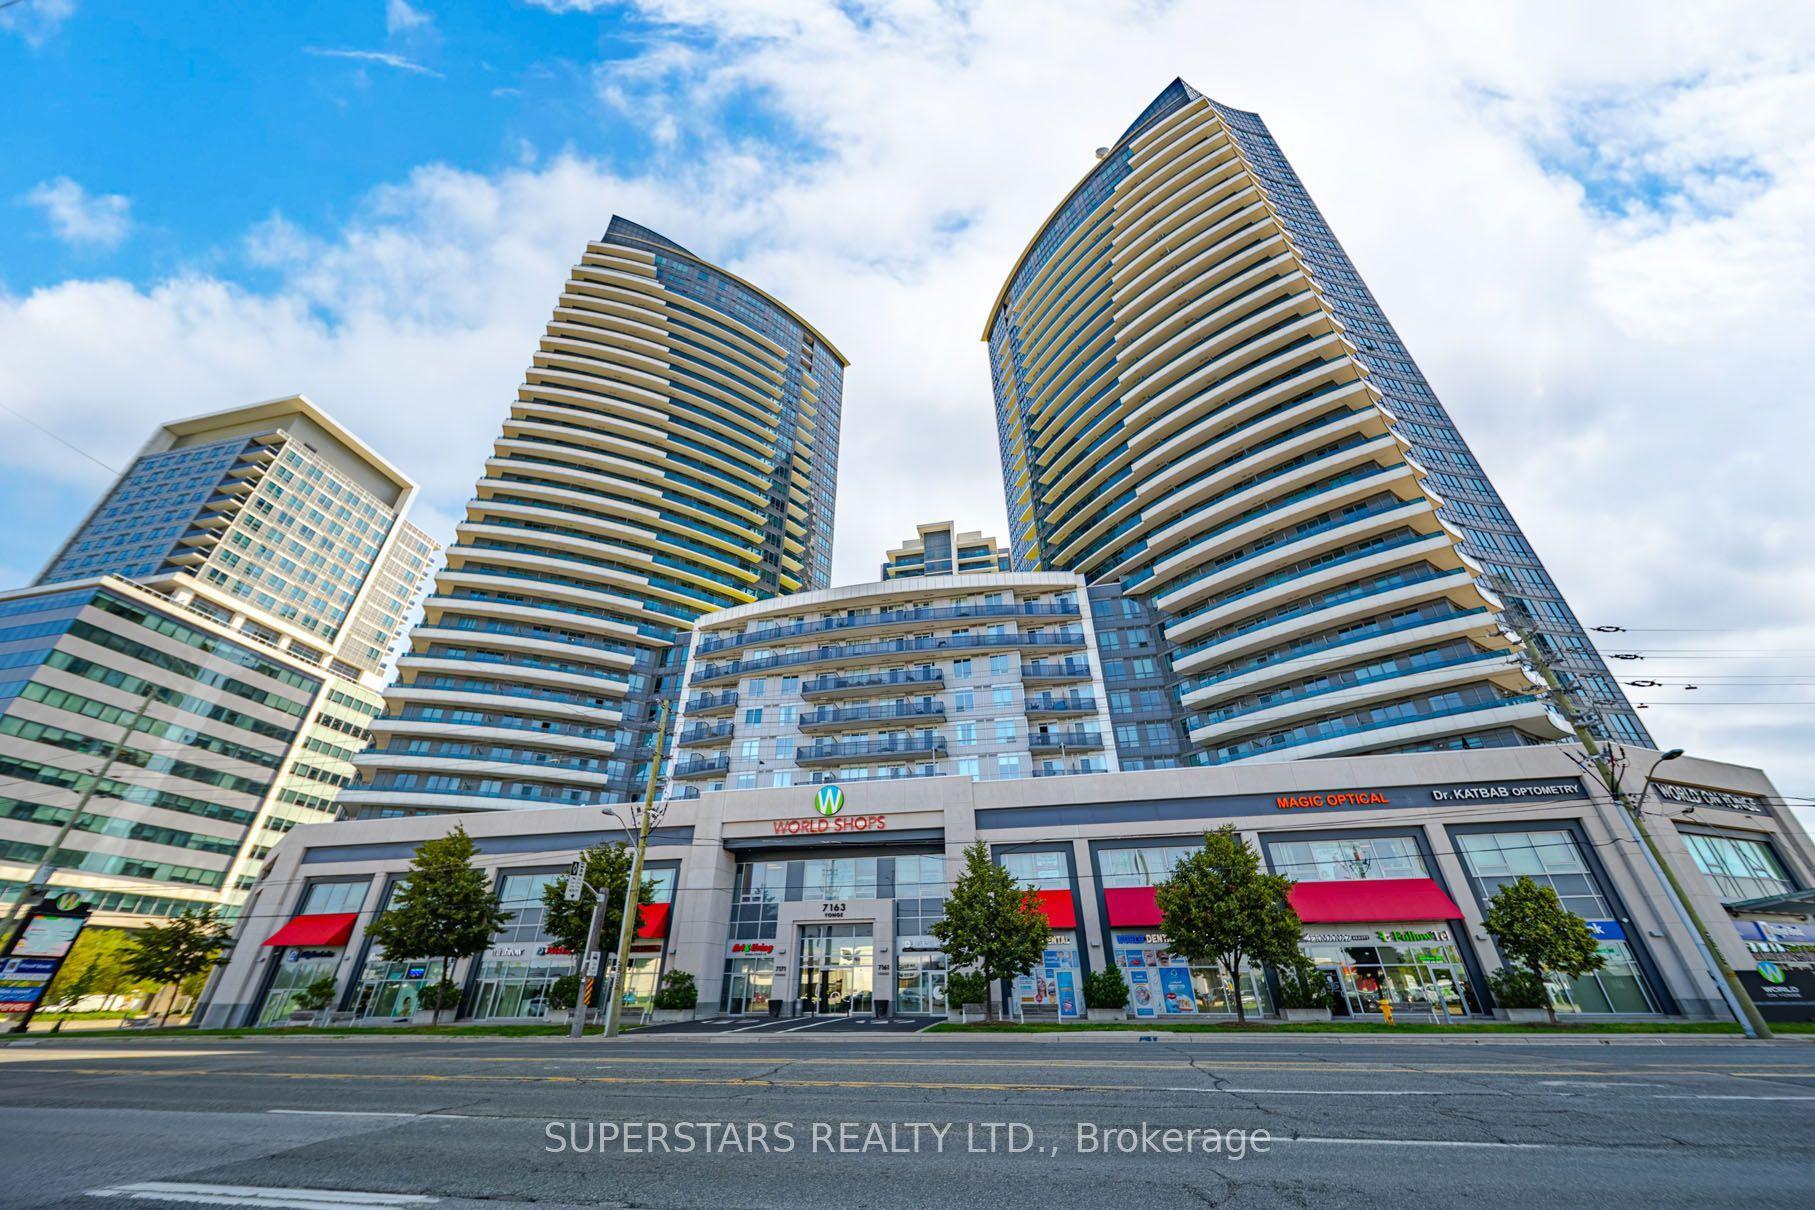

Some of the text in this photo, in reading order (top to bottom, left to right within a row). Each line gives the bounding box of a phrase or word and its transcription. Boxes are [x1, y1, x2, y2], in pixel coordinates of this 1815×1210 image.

[1276, 792, 1390, 809] MAGIC OPTICAL
[1432, 784, 1579, 800] Dr. KATBAB OPTOMETRY
[1655, 783, 1701, 804] WORLD
[1700, 790, 1722, 806] ON
[773, 815, 886, 834] WORLD SHOPS
[822, 903, 846, 912] 7163
